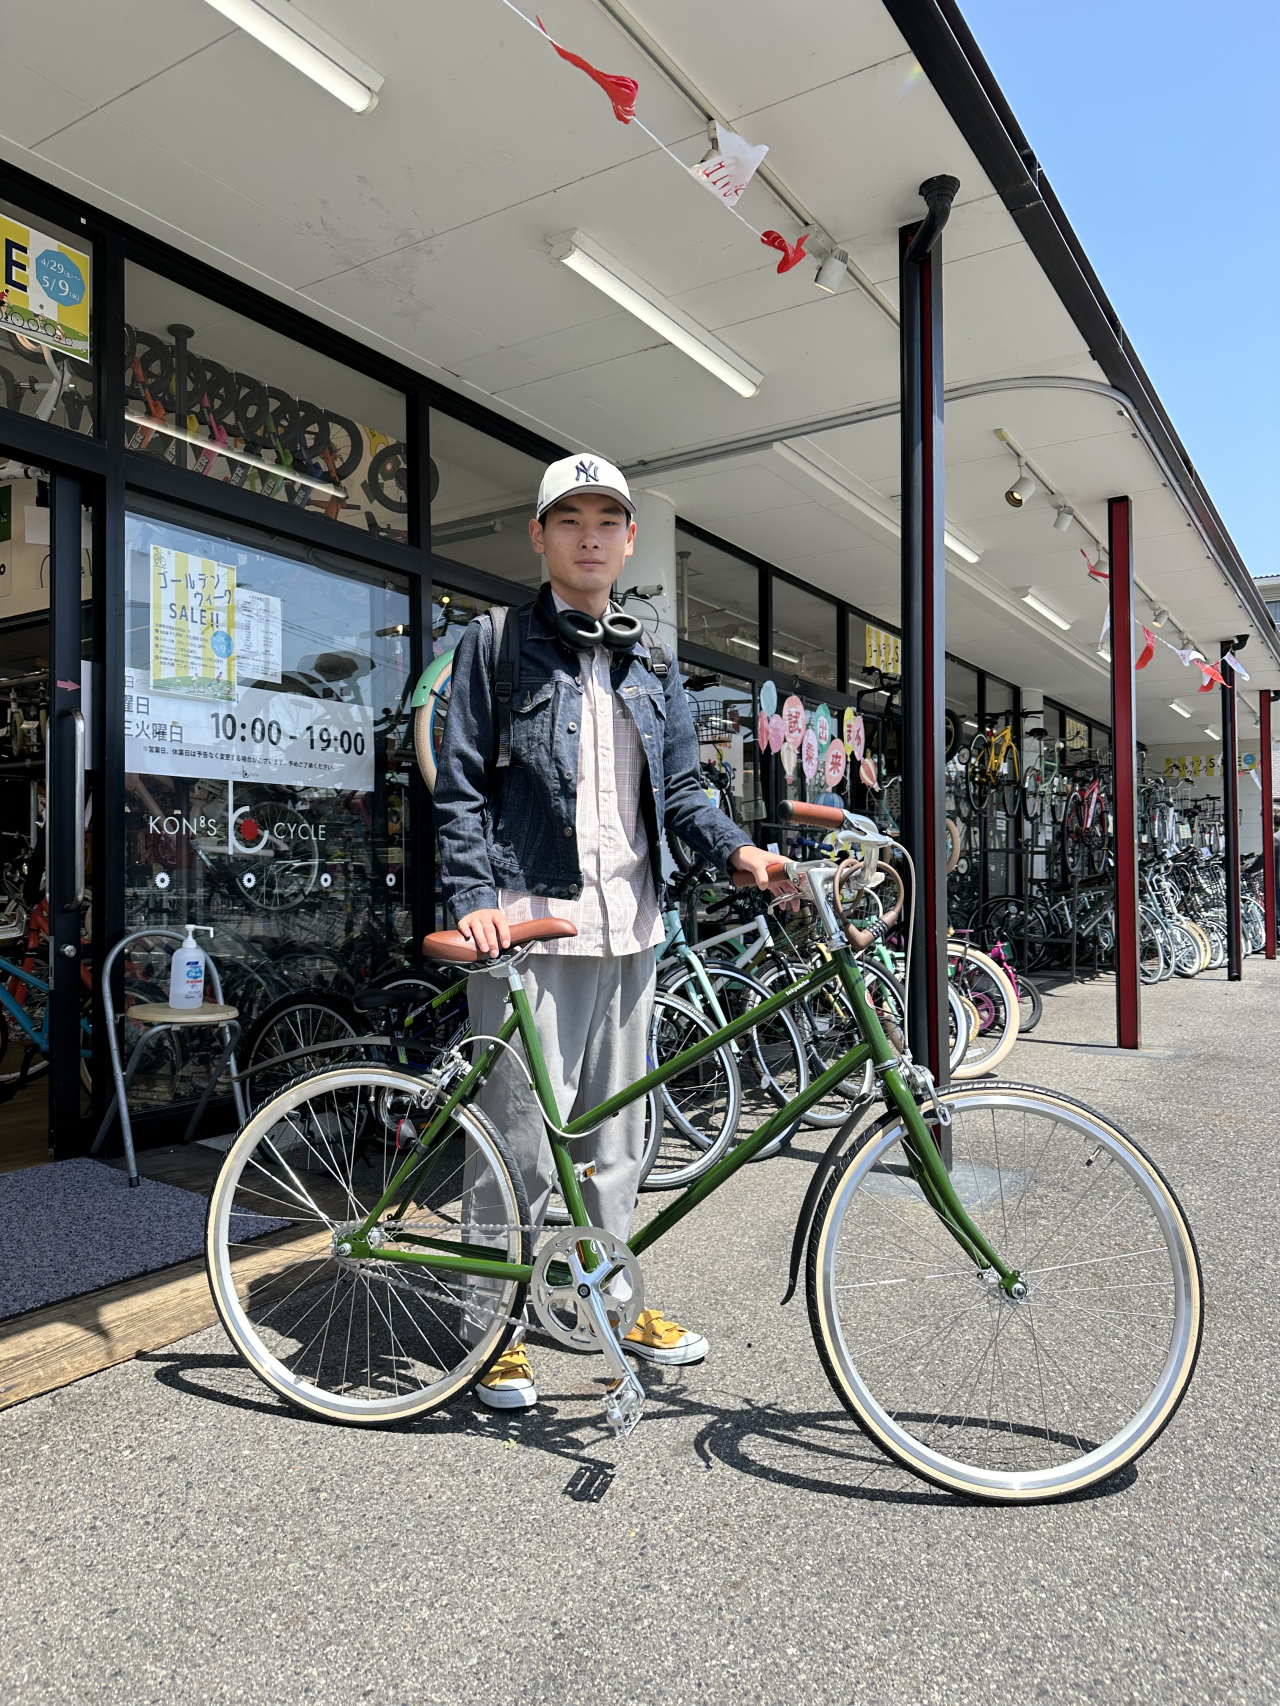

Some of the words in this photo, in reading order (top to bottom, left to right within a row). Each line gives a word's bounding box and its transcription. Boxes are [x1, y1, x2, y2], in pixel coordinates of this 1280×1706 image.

[4, 237, 28, 293] E
[575, 460, 599, 482] NY
[157, 571, 220, 590] ゴールデン
[194, 589, 232, 607] ウィーク
[169, 602, 219, 628] SALE!!
[210, 712, 282, 746] 10:00
[305, 725, 365, 756] 19:00
[273, 822, 326, 841] CYCLE
[785, 979, 810, 996] tokyobike
